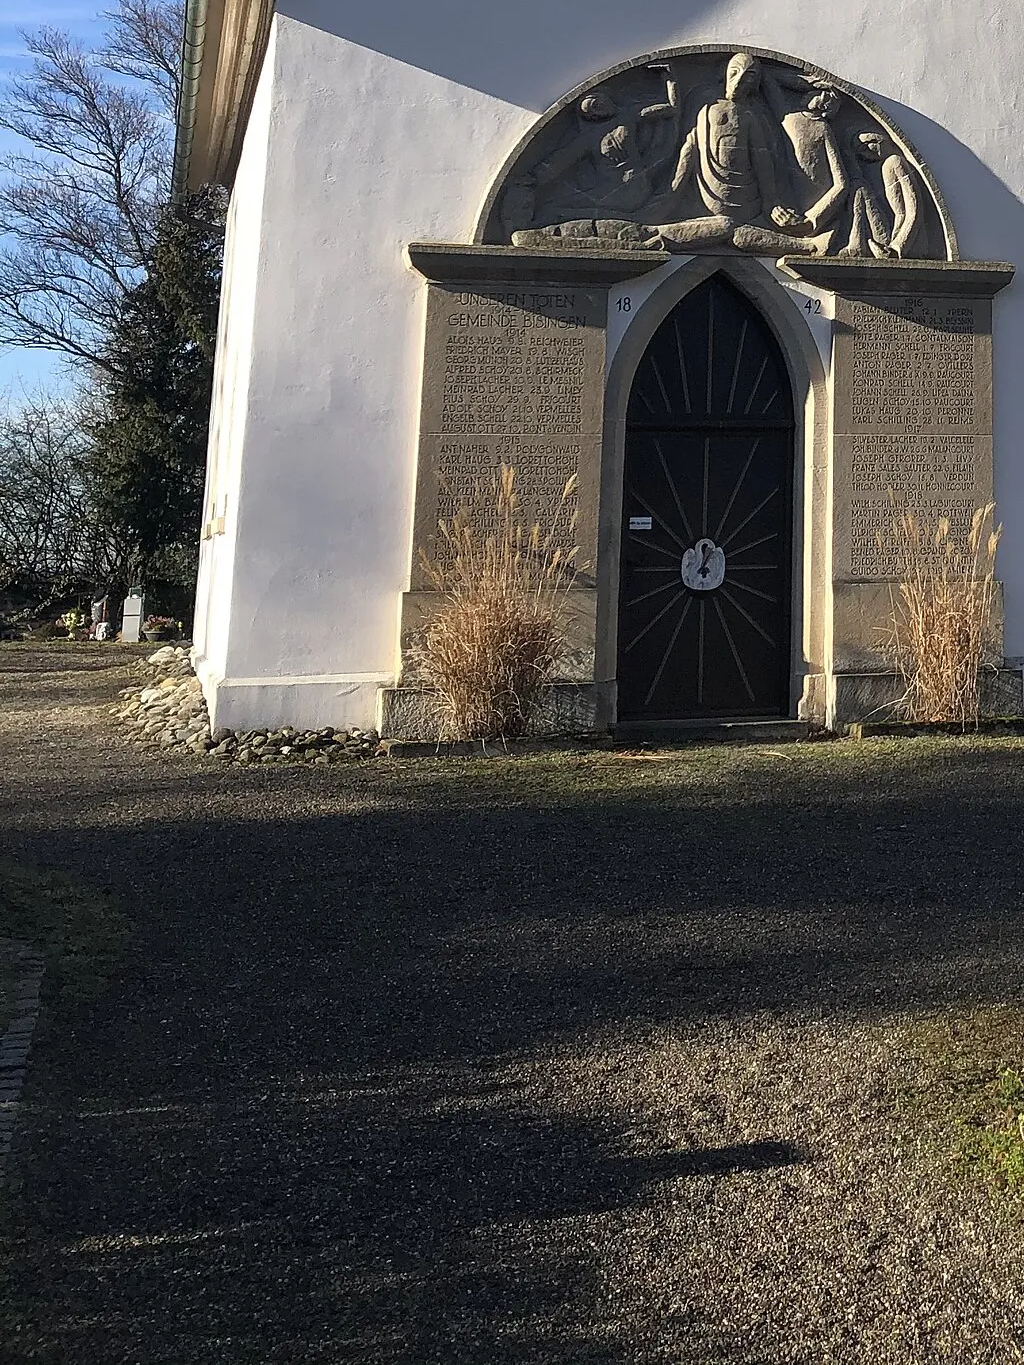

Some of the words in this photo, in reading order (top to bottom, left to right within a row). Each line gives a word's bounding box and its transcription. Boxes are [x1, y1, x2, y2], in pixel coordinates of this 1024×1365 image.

[460, 292, 524, 307] UNSEREN
[528, 293, 576, 308] TOTEN
[904, 299, 922, 308] 1916
[616, 298, 632, 313] 18
[804, 298, 822, 315] 42
[854, 306, 882, 315] FABIAN
[948, 308, 974, 317] YPERN
[448, 314, 518, 328] GEMEINDE
[524, 315, 586, 329] BISINGEN
[504, 328, 526, 337] 1914
[853, 324, 882, 333] JOSEPH
[883, 324, 910, 333] SCHELL
[447, 336, 474, 345] ALOIS
[478, 337, 502, 345] HAUG
[446, 346, 488, 355] FRIEDRICH
[556, 347, 584, 356] WISCH
[853, 343, 891, 351] HERMANN
[896, 343, 920, 351] SCHELL
[940, 344, 974, 352] FRICOURT
[446, 356, 476, 364] GEORG
[852, 352, 879, 360] JOSEPH
[853, 361, 881, 369] ANTON
[938, 362, 974, 370] OVILLERS
[445, 366, 477, 374] ALFRED
[479, 366, 510, 375] SCHOY
[852, 370, 881, 378] JOHANN
[937, 370, 974, 379] RAUCOURT
[444, 376, 476, 384] JOSEPH
[478, 376, 510, 384] LACHER
[888, 380, 914, 388] SCHELL
[936, 380, 974, 388] RAUCOURT
[444, 385, 486, 394] MEINRAD
[488, 386, 524, 394] LACHER
[852, 388, 881, 396] JOHANN
[443, 395, 464, 403] PIUS
[470, 395, 502, 404] SCHOY
[852, 398, 878, 406] EUGEN
[883, 398, 910, 406] SCHOY
[934, 398, 974, 406] RAUCOURT
[442, 405, 472, 413] ADOLF
[476, 405, 508, 413] SCHOY
[536, 405, 582, 413] VERMELLES
[852, 407, 876, 415] LUKAS
[880, 407, 901, 415] HAUG
[476, 415, 506, 423] SCHELL
[536, 415, 582, 423] VERMELLES
[852, 416, 873, 424] KARL
[876, 416, 918, 424] SCHILLING
[442, 424, 476, 433] AUGUST
[478, 424, 496, 433] OTT
[904, 425, 922, 433] 1917
[852, 436, 888, 444] SILVESTER
[890, 436, 918, 444] LACHER
[440, 455, 462, 464] KARL
[465, 455, 492, 464] HAUG
[852, 455, 884, 463] JOSEPH
[438, 466, 477, 474] MEINRAD
[480, 466, 498, 474] OTT
[852, 464, 876, 472] FRANZ
[878, 464, 900, 472] SALES
[904, 464, 931, 472] SAUTER
[852, 474, 881, 482] JOSEPH
[886, 474, 912, 482] SCHOY
[944, 474, 974, 482] VERDUN
[904, 492, 922, 500] 1918
[852, 510, 880, 518] MARTIN
[852, 519, 892, 527] EMMERICH
[852, 567, 878, 576] GUIDO
